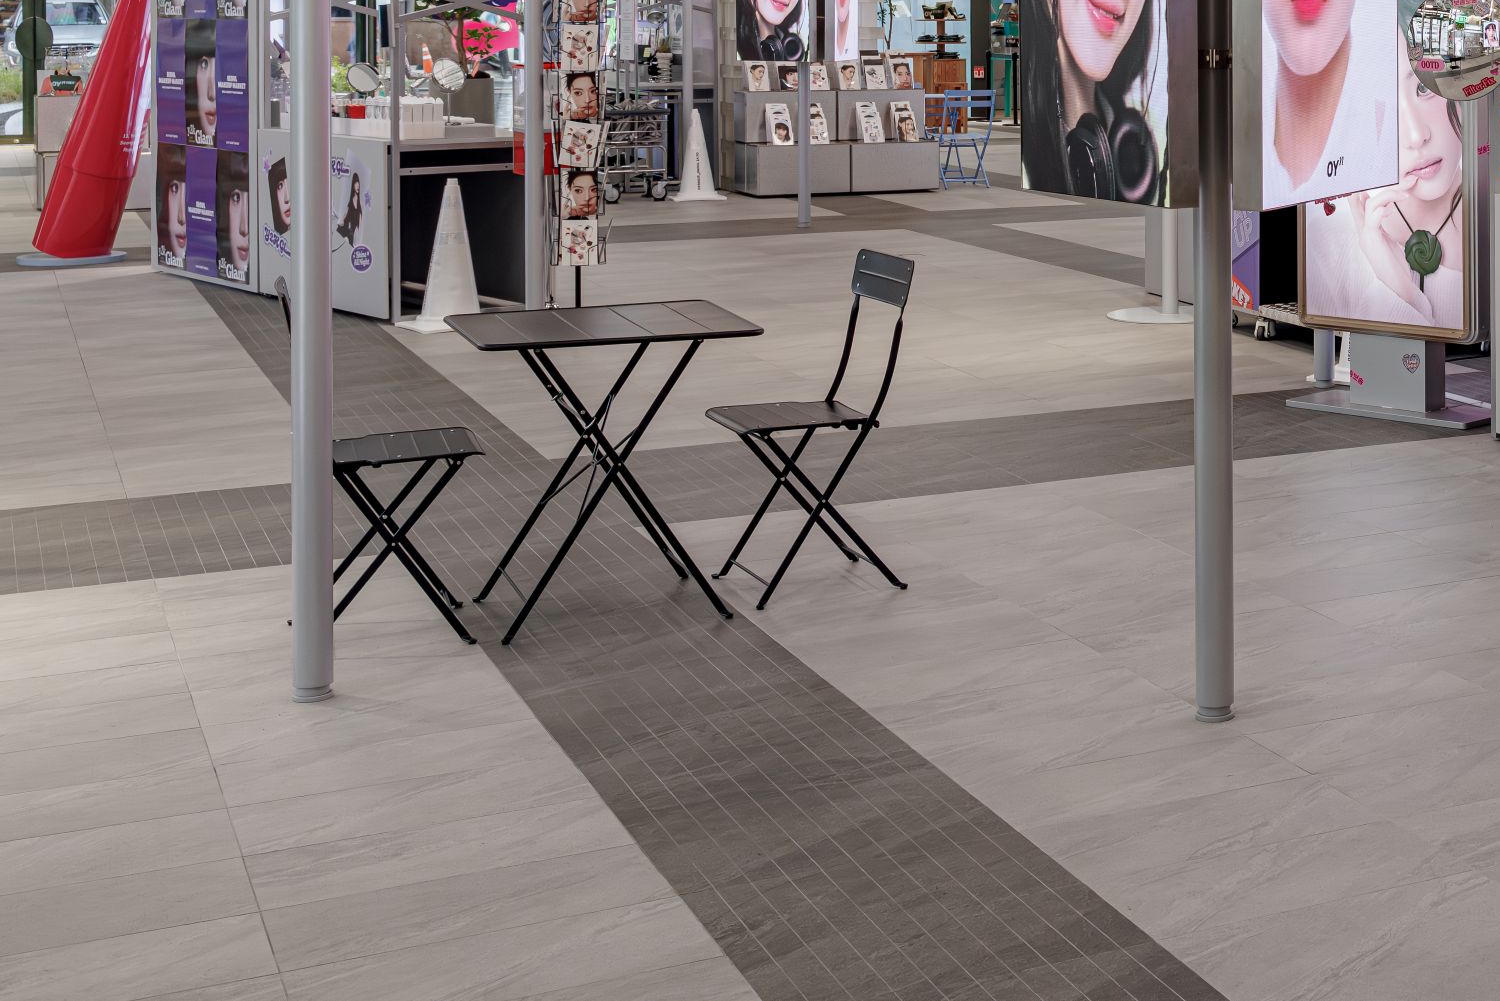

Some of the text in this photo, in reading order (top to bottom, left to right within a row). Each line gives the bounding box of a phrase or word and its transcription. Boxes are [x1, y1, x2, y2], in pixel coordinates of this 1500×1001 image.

[164, 0, 183, 16] Glam
[224, 0, 245, 17] Glam
[1420, 60, 1440, 69] OOTD
[1464, 77, 1496, 97] Filter Fix
[195, 129, 214, 146] Glam
[165, 250, 184, 268] Glam
[225, 263, 246, 282] Glam
